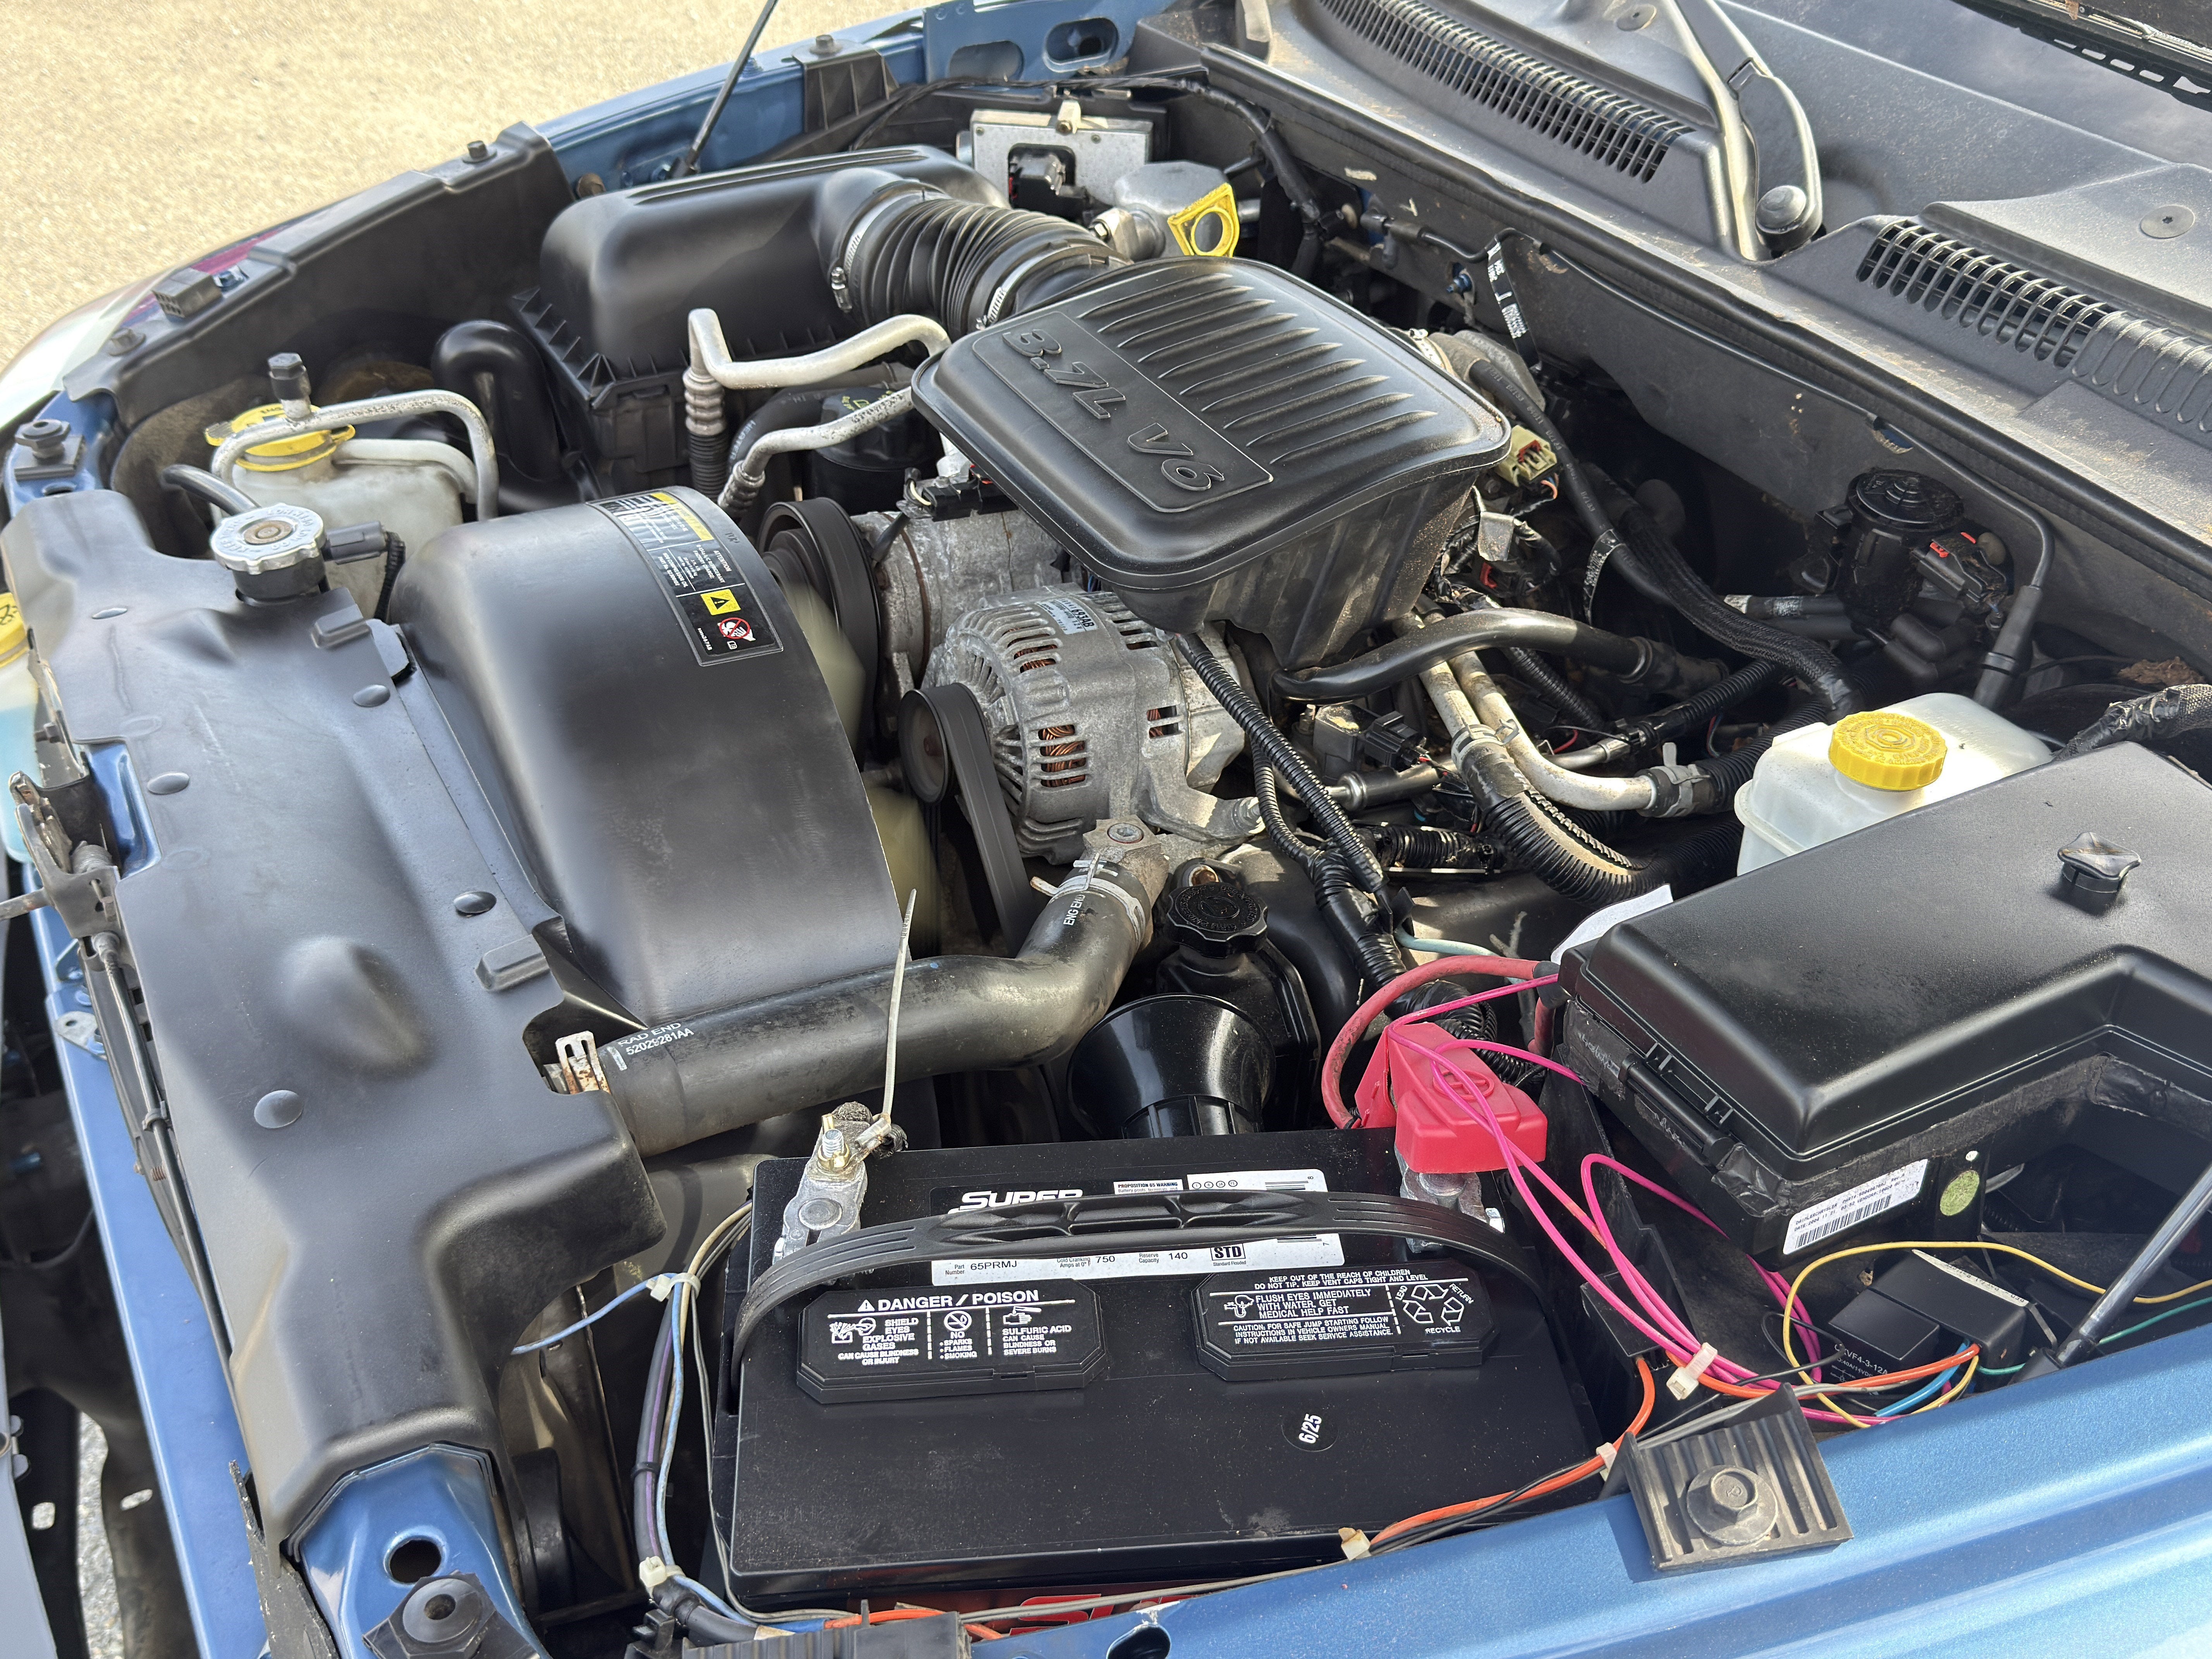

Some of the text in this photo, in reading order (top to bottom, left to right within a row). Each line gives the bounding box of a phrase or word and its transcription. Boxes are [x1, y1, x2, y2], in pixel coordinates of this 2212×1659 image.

[1003, 329, 1224, 491] 3.7L V6
[693, 550, 706, 564] FACTORY
[713, 550, 732, 572] ATTENTION
[708, 561, 725, 583] REFRIGERANT
[1063, 895, 1085, 926] ENG END
[618, 1023, 681, 1047] RAD END
[626, 1028, 694, 1055] 52029281AA
[1795, 1203, 1837, 1225] DAIMLERCHRYSLER
[1214, 1246, 1241, 1258] STD
[970, 1261, 1017, 1270] 65PRMJ
[1255, 1288, 1371, 1303] FLUSH EYES IMMEDIATELY
[1395, 1285, 1407, 1300] LEAD
[1449, 1283, 1474, 1304] RETURN
[878, 1290, 1039, 1311] DANGER / POISON
[1257, 1302, 1279, 1311] WITH
[1319, 1298, 1336, 1307] GET
[1259, 1306, 1349, 1319] MEDICAL HELP FAST
[885, 1318, 919, 1326] SHIELD
[1324, 1318, 1359, 1326] STARTING
[885, 1326, 910, 1334] EYES
[1002, 1325, 1072, 1335] SULFURIC ACID
[1235, 1329, 1285, 1338] INSTRUCTIONS
[863, 1333, 915, 1343] EXPLOSIVE
[862, 1342, 895, 1351] GASES
[1004, 1347, 1031, 1355] SEVERE
[854, 1351, 879, 1359] CAUSE
[879, 1349, 919, 1358] BLINDNESS
[944, 1351, 977, 1359] SMOKING
[874, 1357, 900, 1365] INJURY
[1298, 1413, 1322, 1444] 6/25
